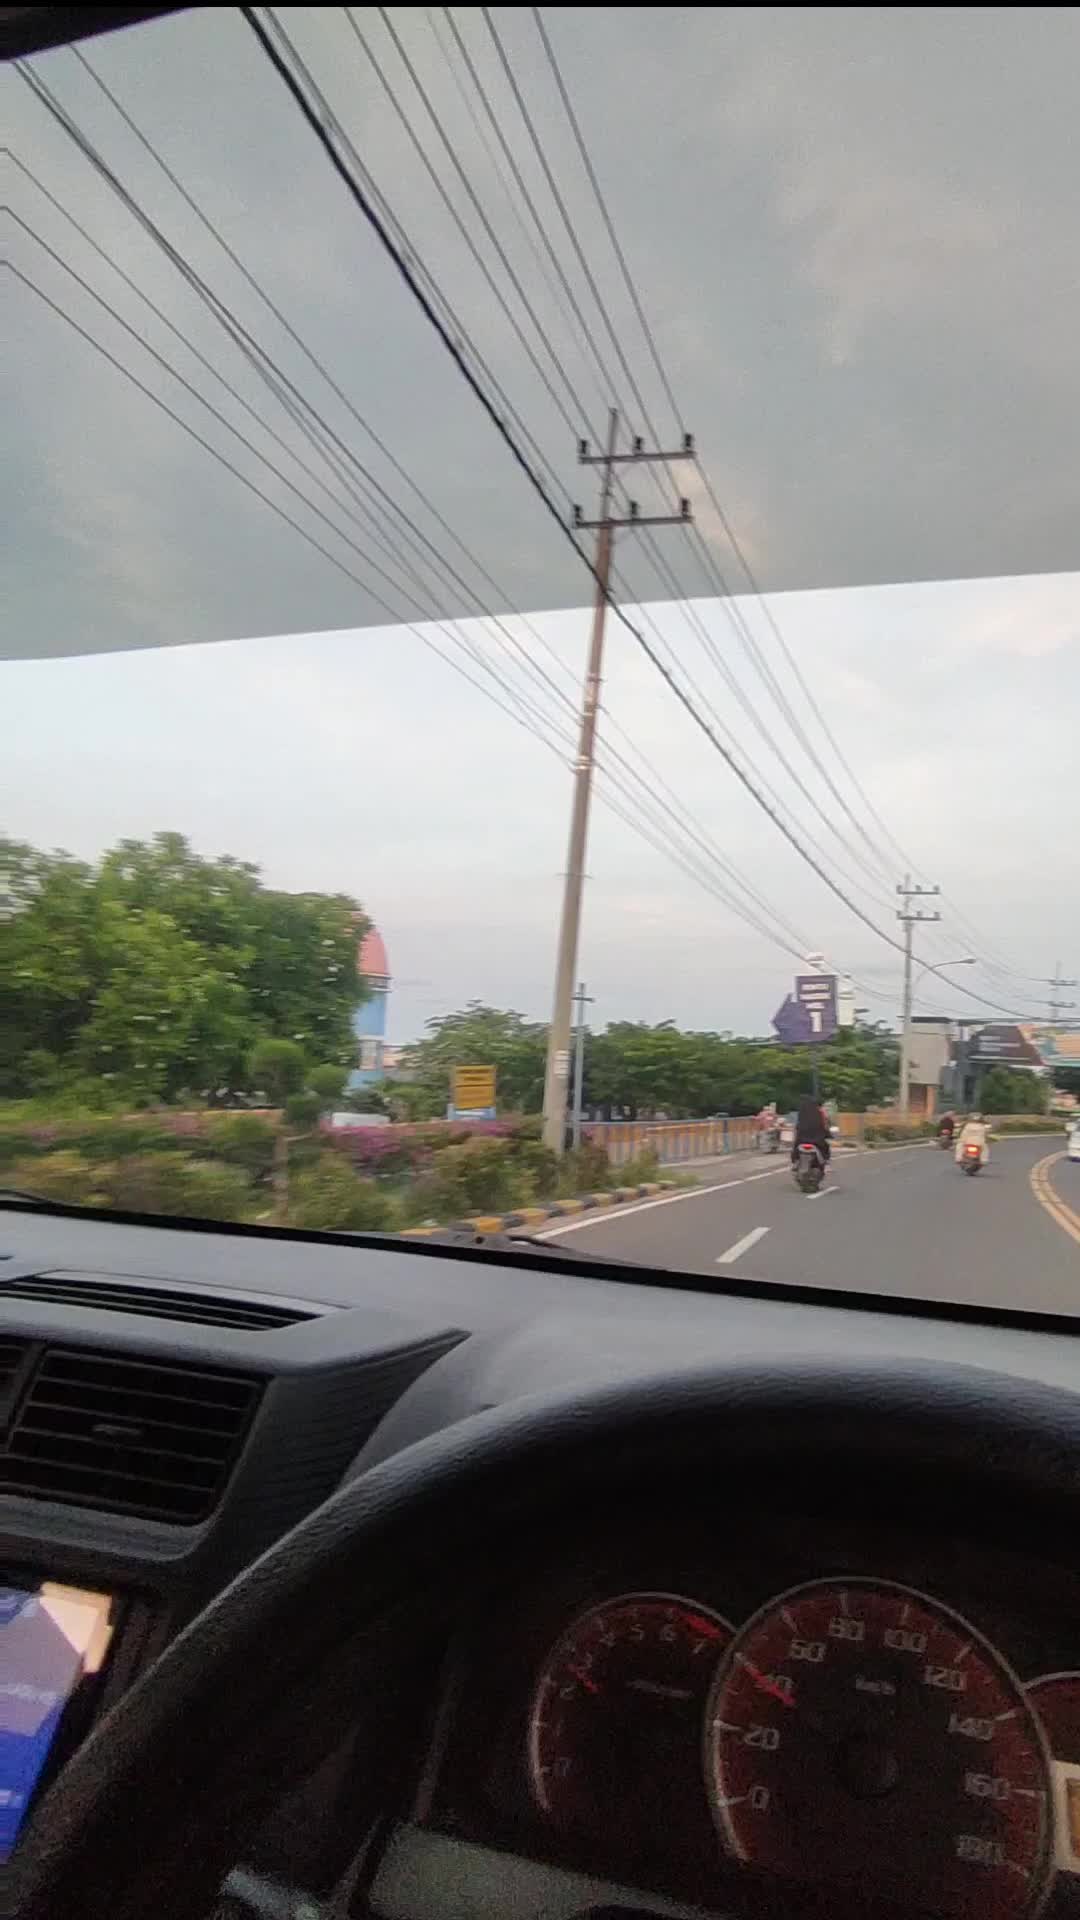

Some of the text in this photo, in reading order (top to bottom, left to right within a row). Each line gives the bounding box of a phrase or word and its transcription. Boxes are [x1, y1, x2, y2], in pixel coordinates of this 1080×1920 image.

[923, 1665, 965, 1691] 120
[742, 1724, 779, 1750] 20
[750, 1786, 769, 1809] 0
